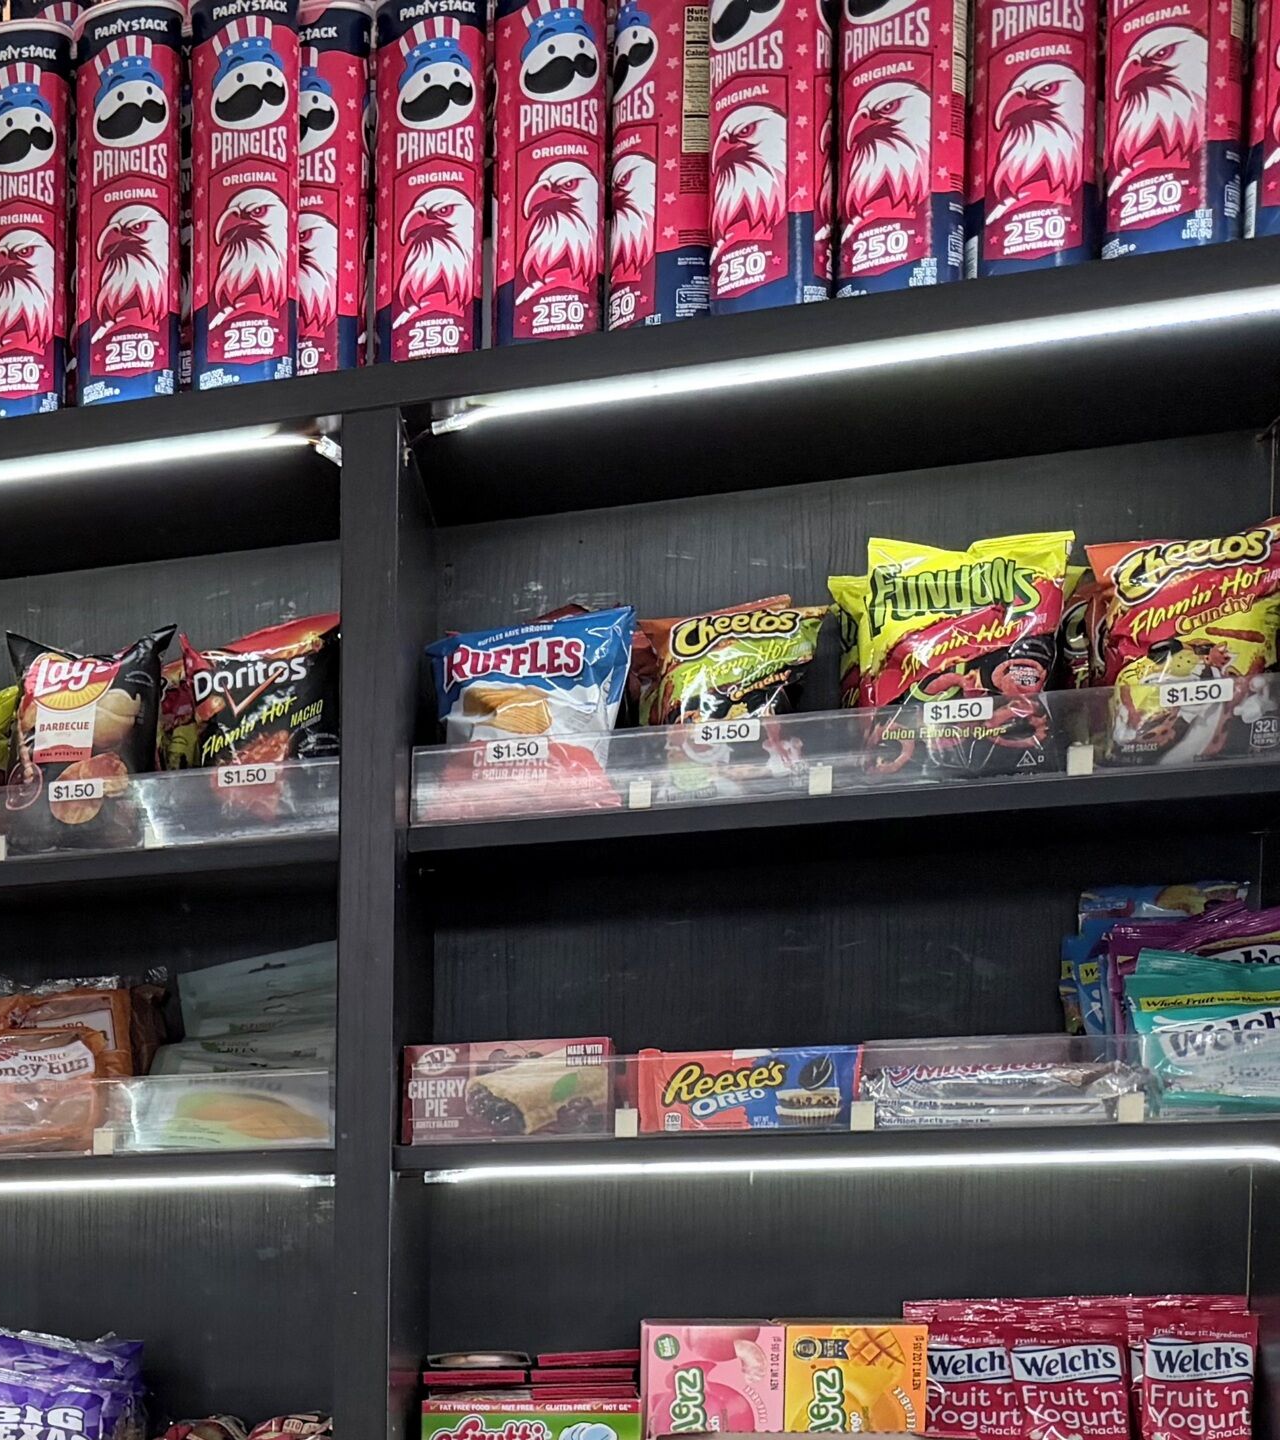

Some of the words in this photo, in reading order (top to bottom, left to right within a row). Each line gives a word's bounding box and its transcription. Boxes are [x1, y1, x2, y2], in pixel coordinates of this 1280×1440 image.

[1123, 4, 1191, 34] ORIGINAL
[844, 7, 930, 70] PRINGLES
[1005, 43, 1072, 65] ORIGINAL
[852, 61, 915, 87] ORIGINAL
[715, 84, 769, 111] ORIGINAL
[519, 98, 598, 142] PRINGLES
[211, 125, 287, 169] PRINGLES
[396, 125, 474, 169] PRINGLES
[531, 144, 589, 160] ORIGINAL
[93, 143, 168, 186] PRINGLES
[1114, 529, 1273, 606] Cheetos
[1219, 568, 1266, 597] Hot
[869, 557, 1041, 638] FUNYUNS
[1173, 593, 1256, 637] Crunchy
[671, 609, 802, 660] Cheetos
[192, 657, 307, 701] Doritos
[443, 638, 585, 693] RUFFLES
[1167, 685, 1222, 703] $1.50
[930, 703, 983, 720] $1.50
[39, 721, 90, 732] BARBECUE
[700, 724, 751, 742] $1.50
[492, 741, 540, 759] $1.50
[223, 769, 268, 784] $1.50
[53, 783, 95, 799] $1.50
[48, 1057, 90, 1075] Bun
[408, 1080, 466, 1099] CHERRY
[663, 1060, 788, 1107] Reese's
[424, 1099, 448, 1117] PIE
[690, 1087, 766, 1117] OREO
[1013, 1348, 1117, 1377] Welch's
[1144, 1340, 1250, 1374] Welch's
[1023, 1384, 1088, 1407] Fruit
[1150, 1383, 1215, 1408] Fruit
[1027, 1404, 1126, 1430] Yogurt
[1082, 1425, 1127, 1436] Snacks
[1151, 1406, 1252, 1433] Yogurt
[1207, 1425, 1252, 1440] Snacks
